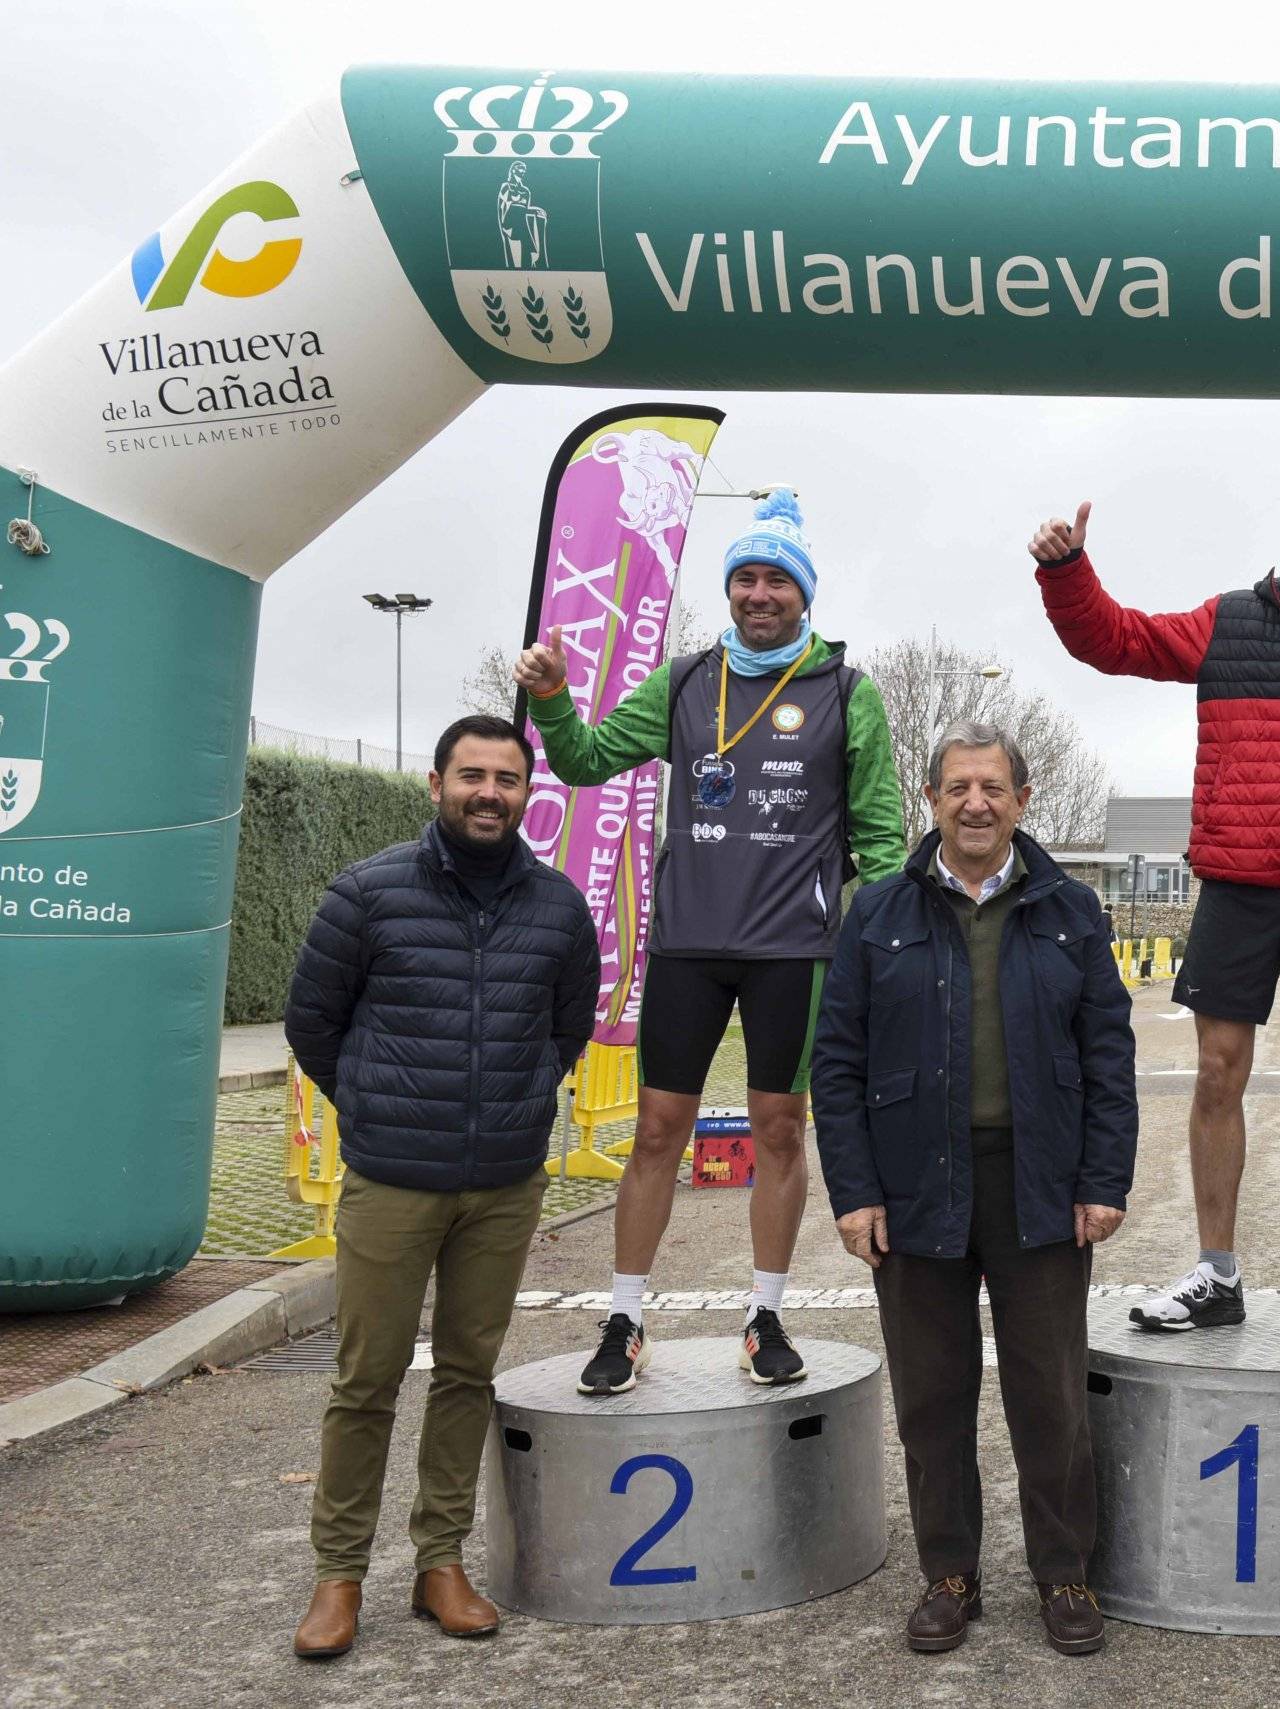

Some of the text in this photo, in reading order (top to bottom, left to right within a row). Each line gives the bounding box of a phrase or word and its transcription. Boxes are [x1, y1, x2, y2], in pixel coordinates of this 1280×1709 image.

[636, 230, 1170, 318] Villanueva
[99, 330, 325, 376] Villanueva
[102, 365, 335, 422] de la Cañada
[106, 413, 342, 454] SENCILLAMENTE TODO
[54, 865, 88, 886] de
[29, 898, 131, 923] Cañada
[609, 1453, 697, 1586] 2
[1200, 1424, 1259, 1582] 1
